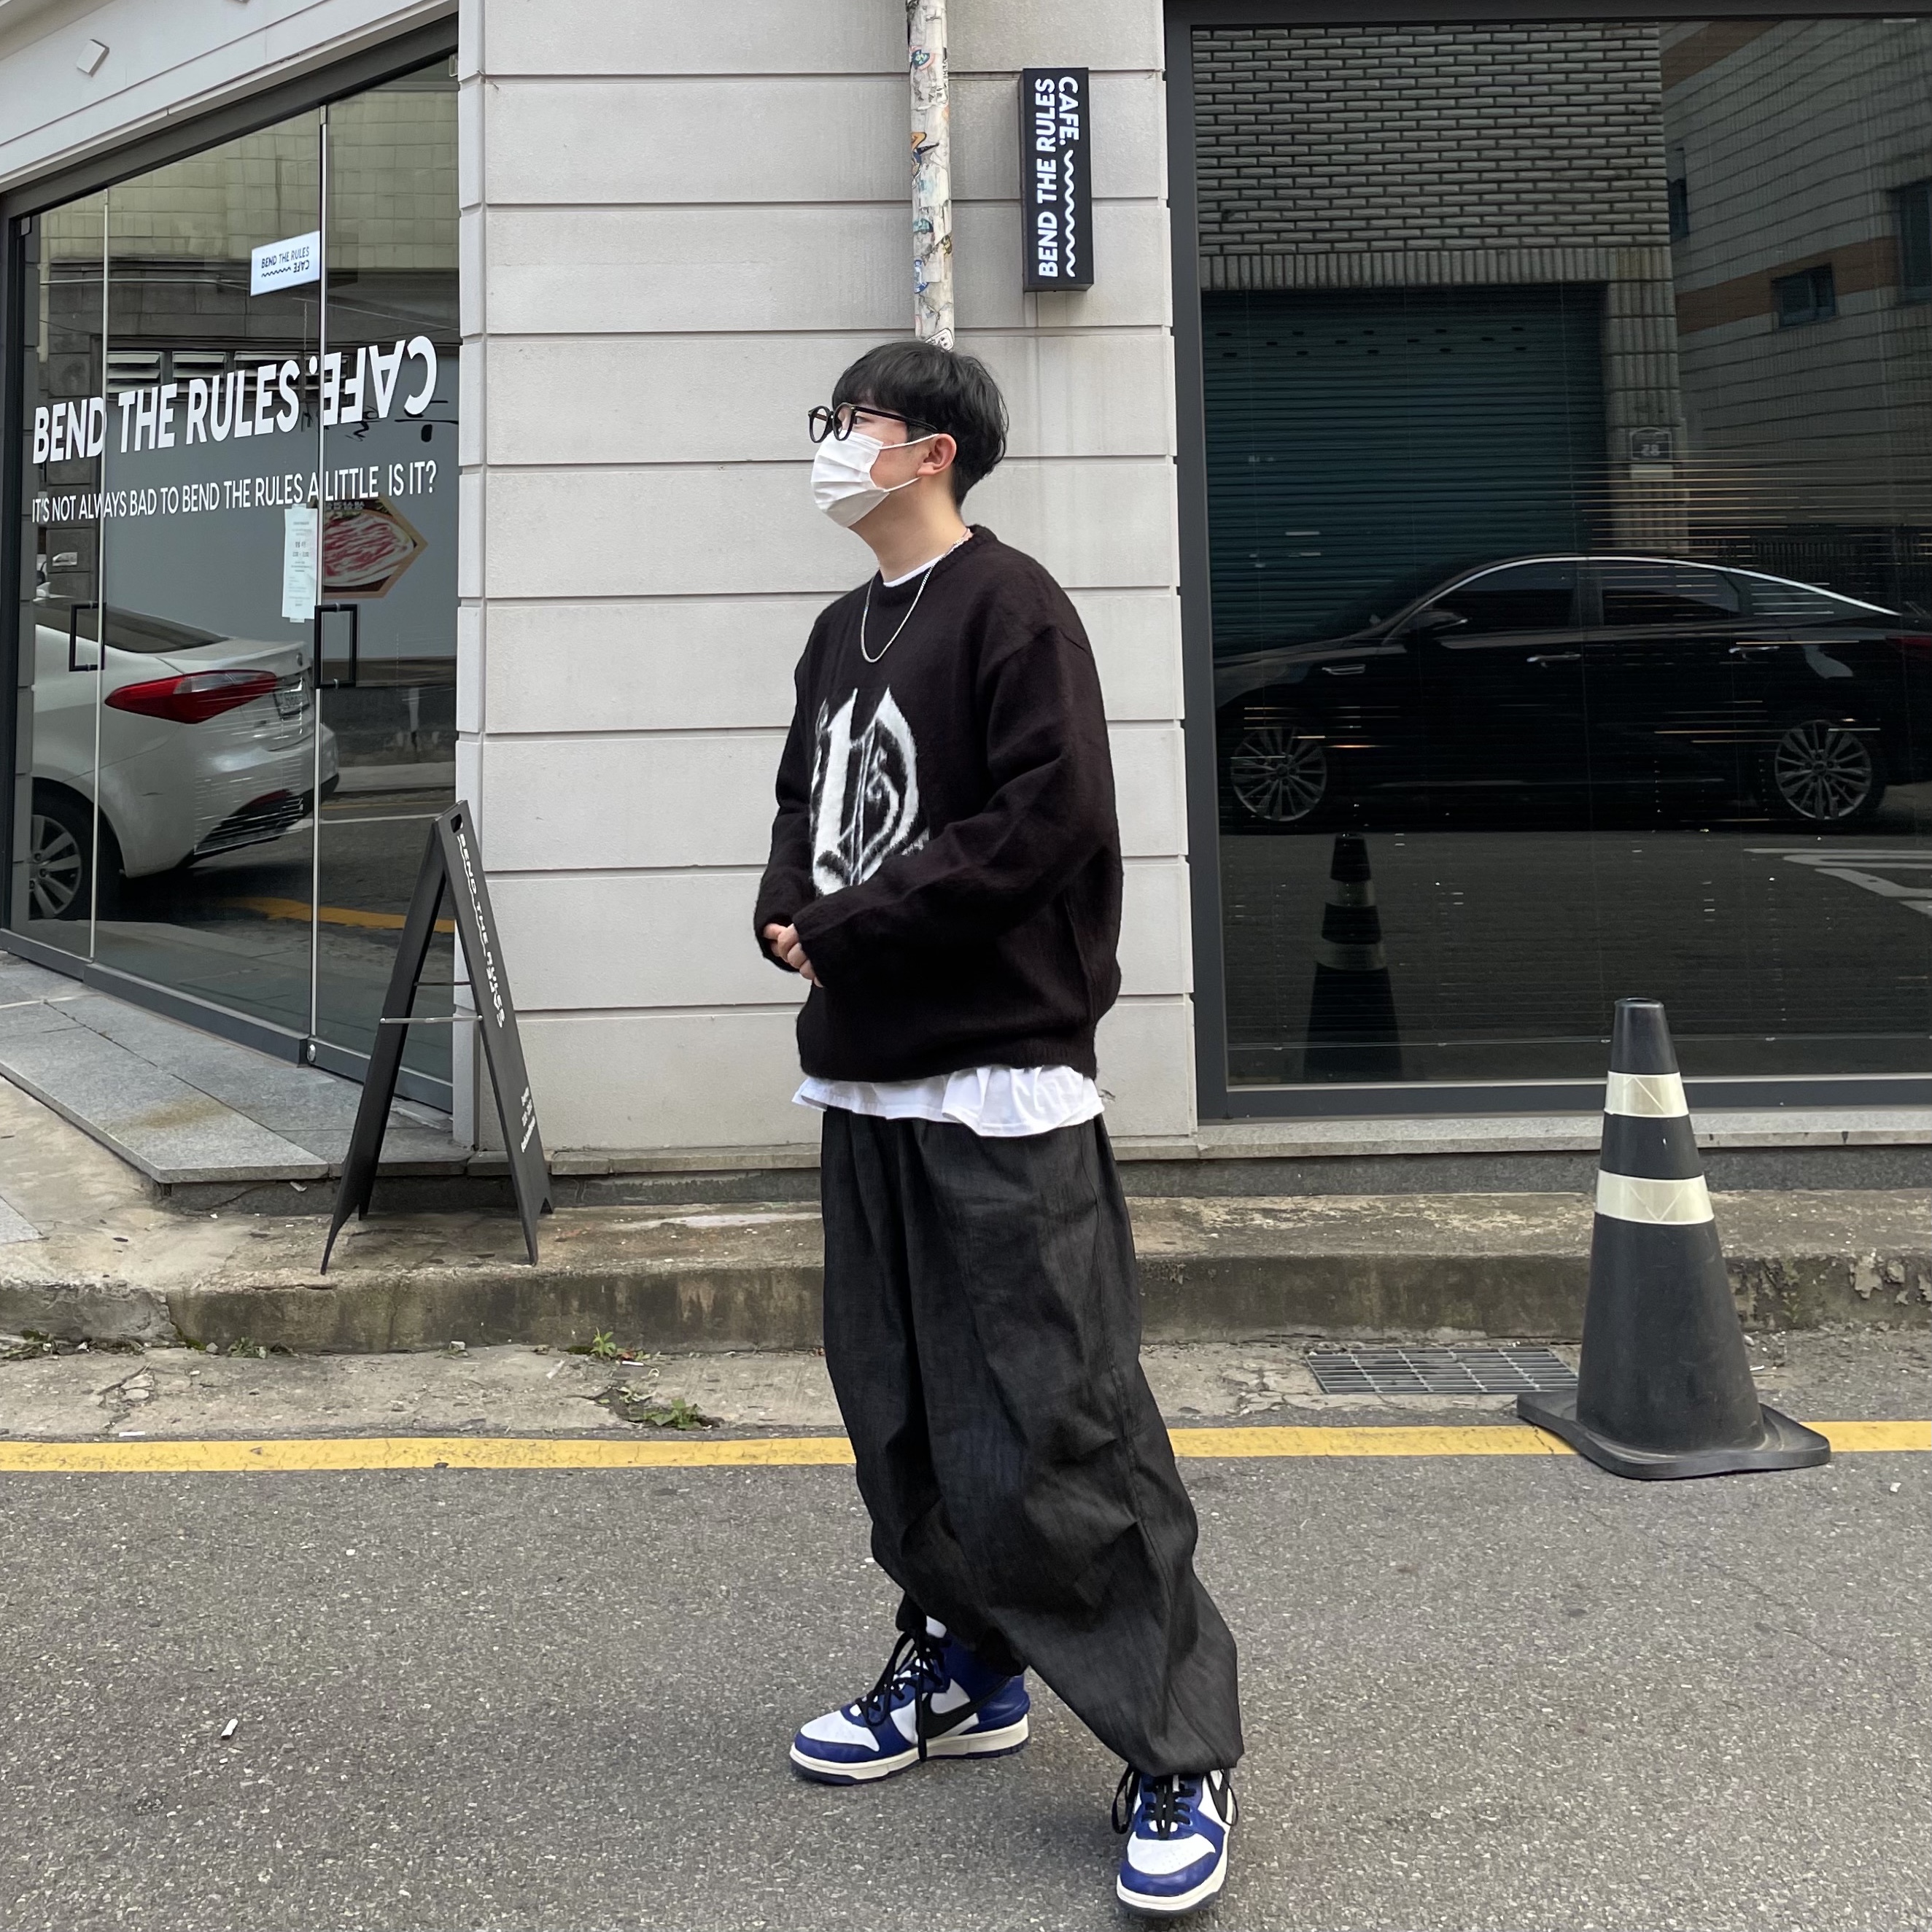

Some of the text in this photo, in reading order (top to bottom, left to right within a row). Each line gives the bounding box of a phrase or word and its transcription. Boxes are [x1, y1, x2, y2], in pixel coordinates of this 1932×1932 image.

[1058, 76, 1079, 145] CAFE.
[1035, 78, 1058, 277] BEND THE RULES
[261, 247, 309, 268] BEND THE RULES
[33, 360, 300, 464] BEND THE RULES
[32, 459, 437, 523] IT'S NOT ALWAYS BAD TO BEND THE RULES A LITTLE IS IT?
[460, 834, 477, 894] BEND
